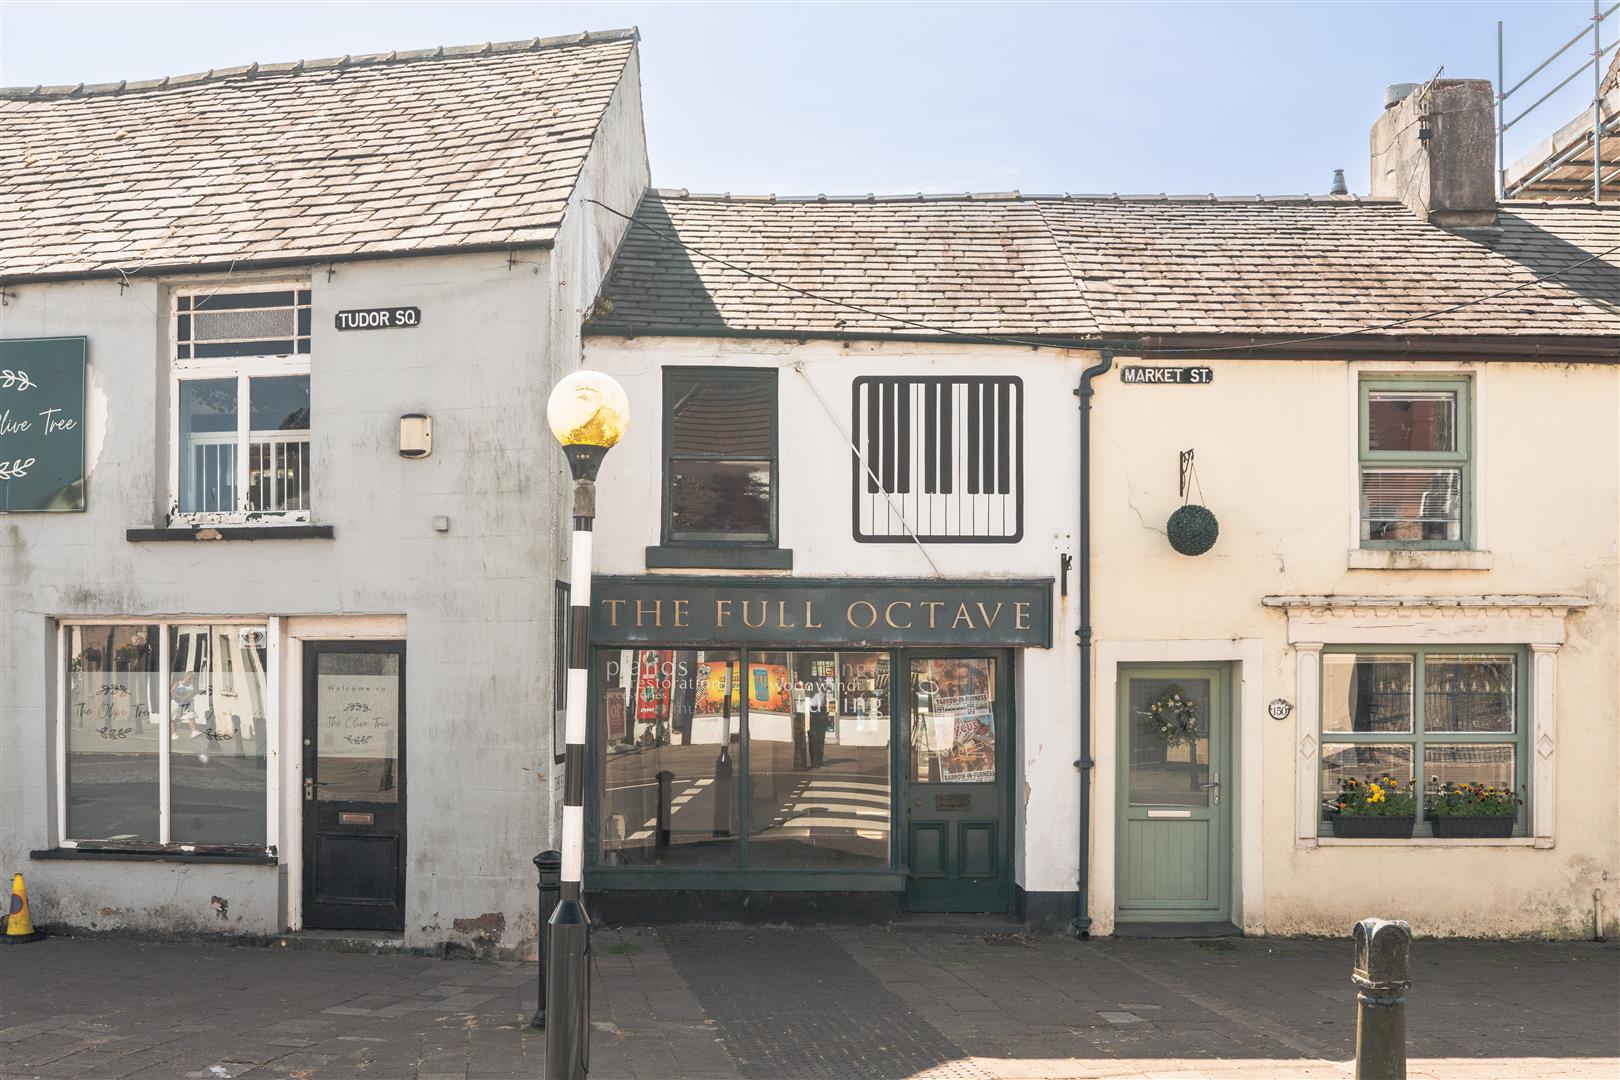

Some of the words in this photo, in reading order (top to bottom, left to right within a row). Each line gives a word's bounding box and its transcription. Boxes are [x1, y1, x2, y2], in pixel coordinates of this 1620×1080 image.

[338, 311, 390, 328] TUDOR
[395, 309, 418, 325] SQ.
[1125, 368, 1183, 382] MARKET
[1190, 368, 1210, 383] ST.
[0, 409, 32, 436] live
[39, 408, 78, 436] Tree
[602, 599, 689, 628] THE
[715, 599, 823, 629] FULL
[847, 600, 1031, 631] OCTAVE
[73, 703, 93, 720] The
[1273, 706, 1288, 716] 150
[325, 715, 342, 728] The
[345, 716, 369, 729] Olive
[372, 717, 393, 728] Tree
